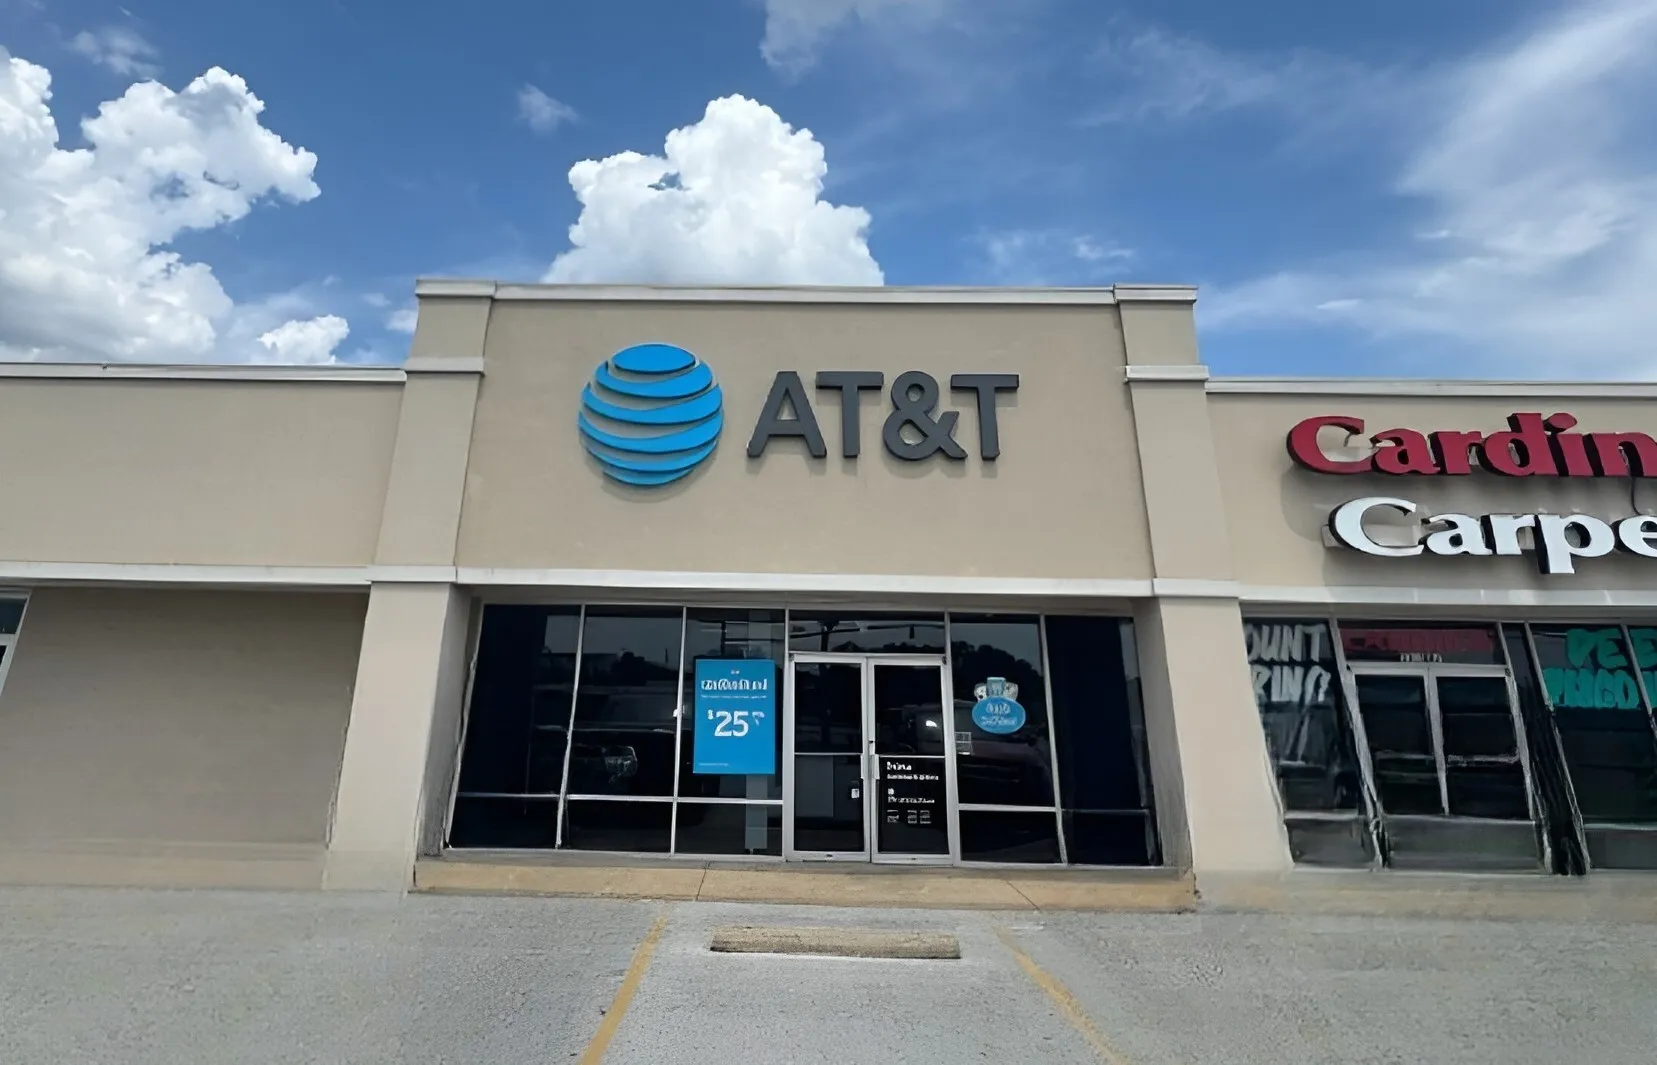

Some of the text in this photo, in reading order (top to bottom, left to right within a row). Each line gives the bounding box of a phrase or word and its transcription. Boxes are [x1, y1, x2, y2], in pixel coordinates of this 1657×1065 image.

[746, 370, 1019, 461] AT&T
[1287, 412, 1657, 477] Cardin
[1328, 497, 1657, 574] Carpe
